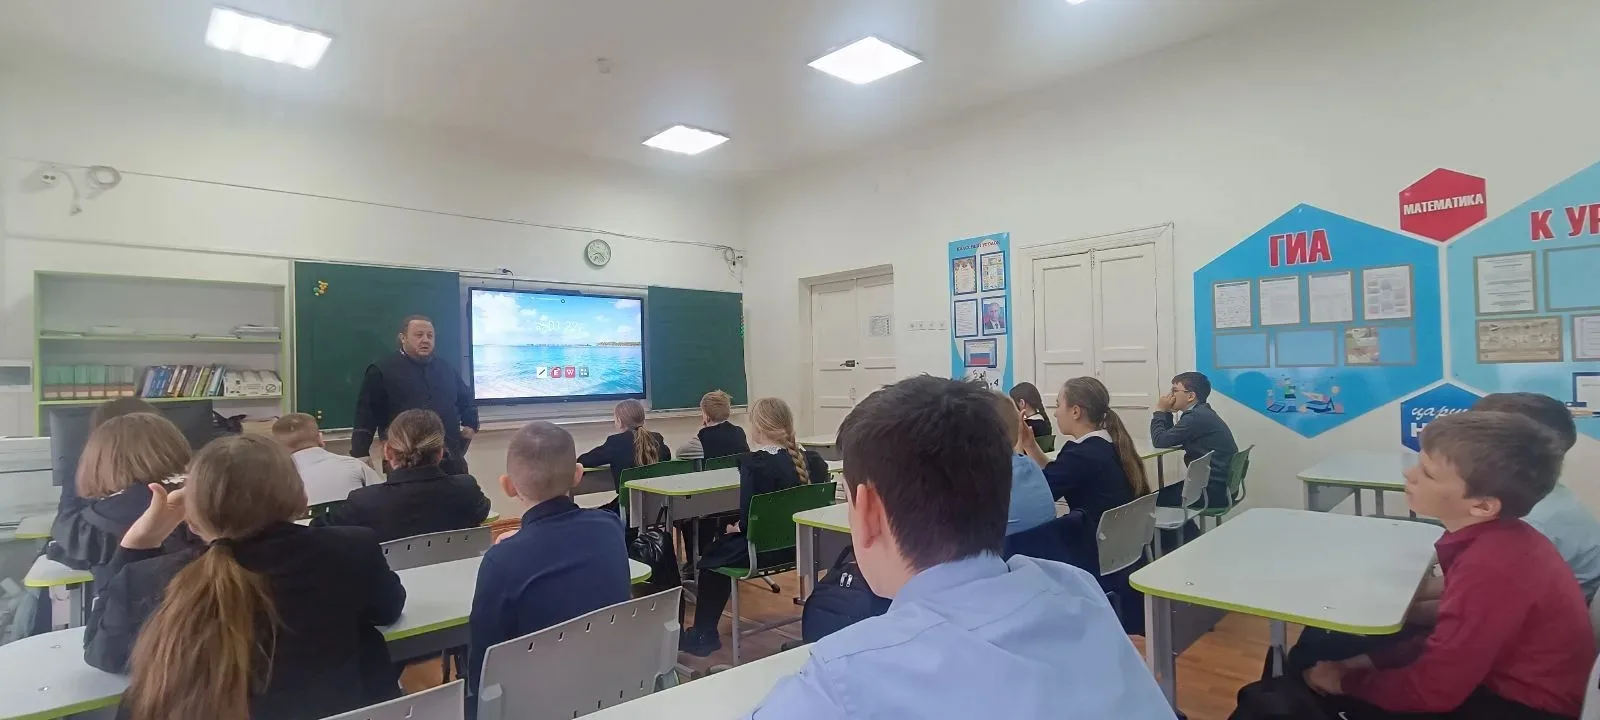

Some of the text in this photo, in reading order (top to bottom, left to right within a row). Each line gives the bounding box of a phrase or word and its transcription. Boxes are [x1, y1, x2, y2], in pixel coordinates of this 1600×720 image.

[1403, 193, 1484, 215] МАТЕМАТИКА
[1529, 208, 1556, 241] К
[1269, 228, 1332, 267] ГИА
